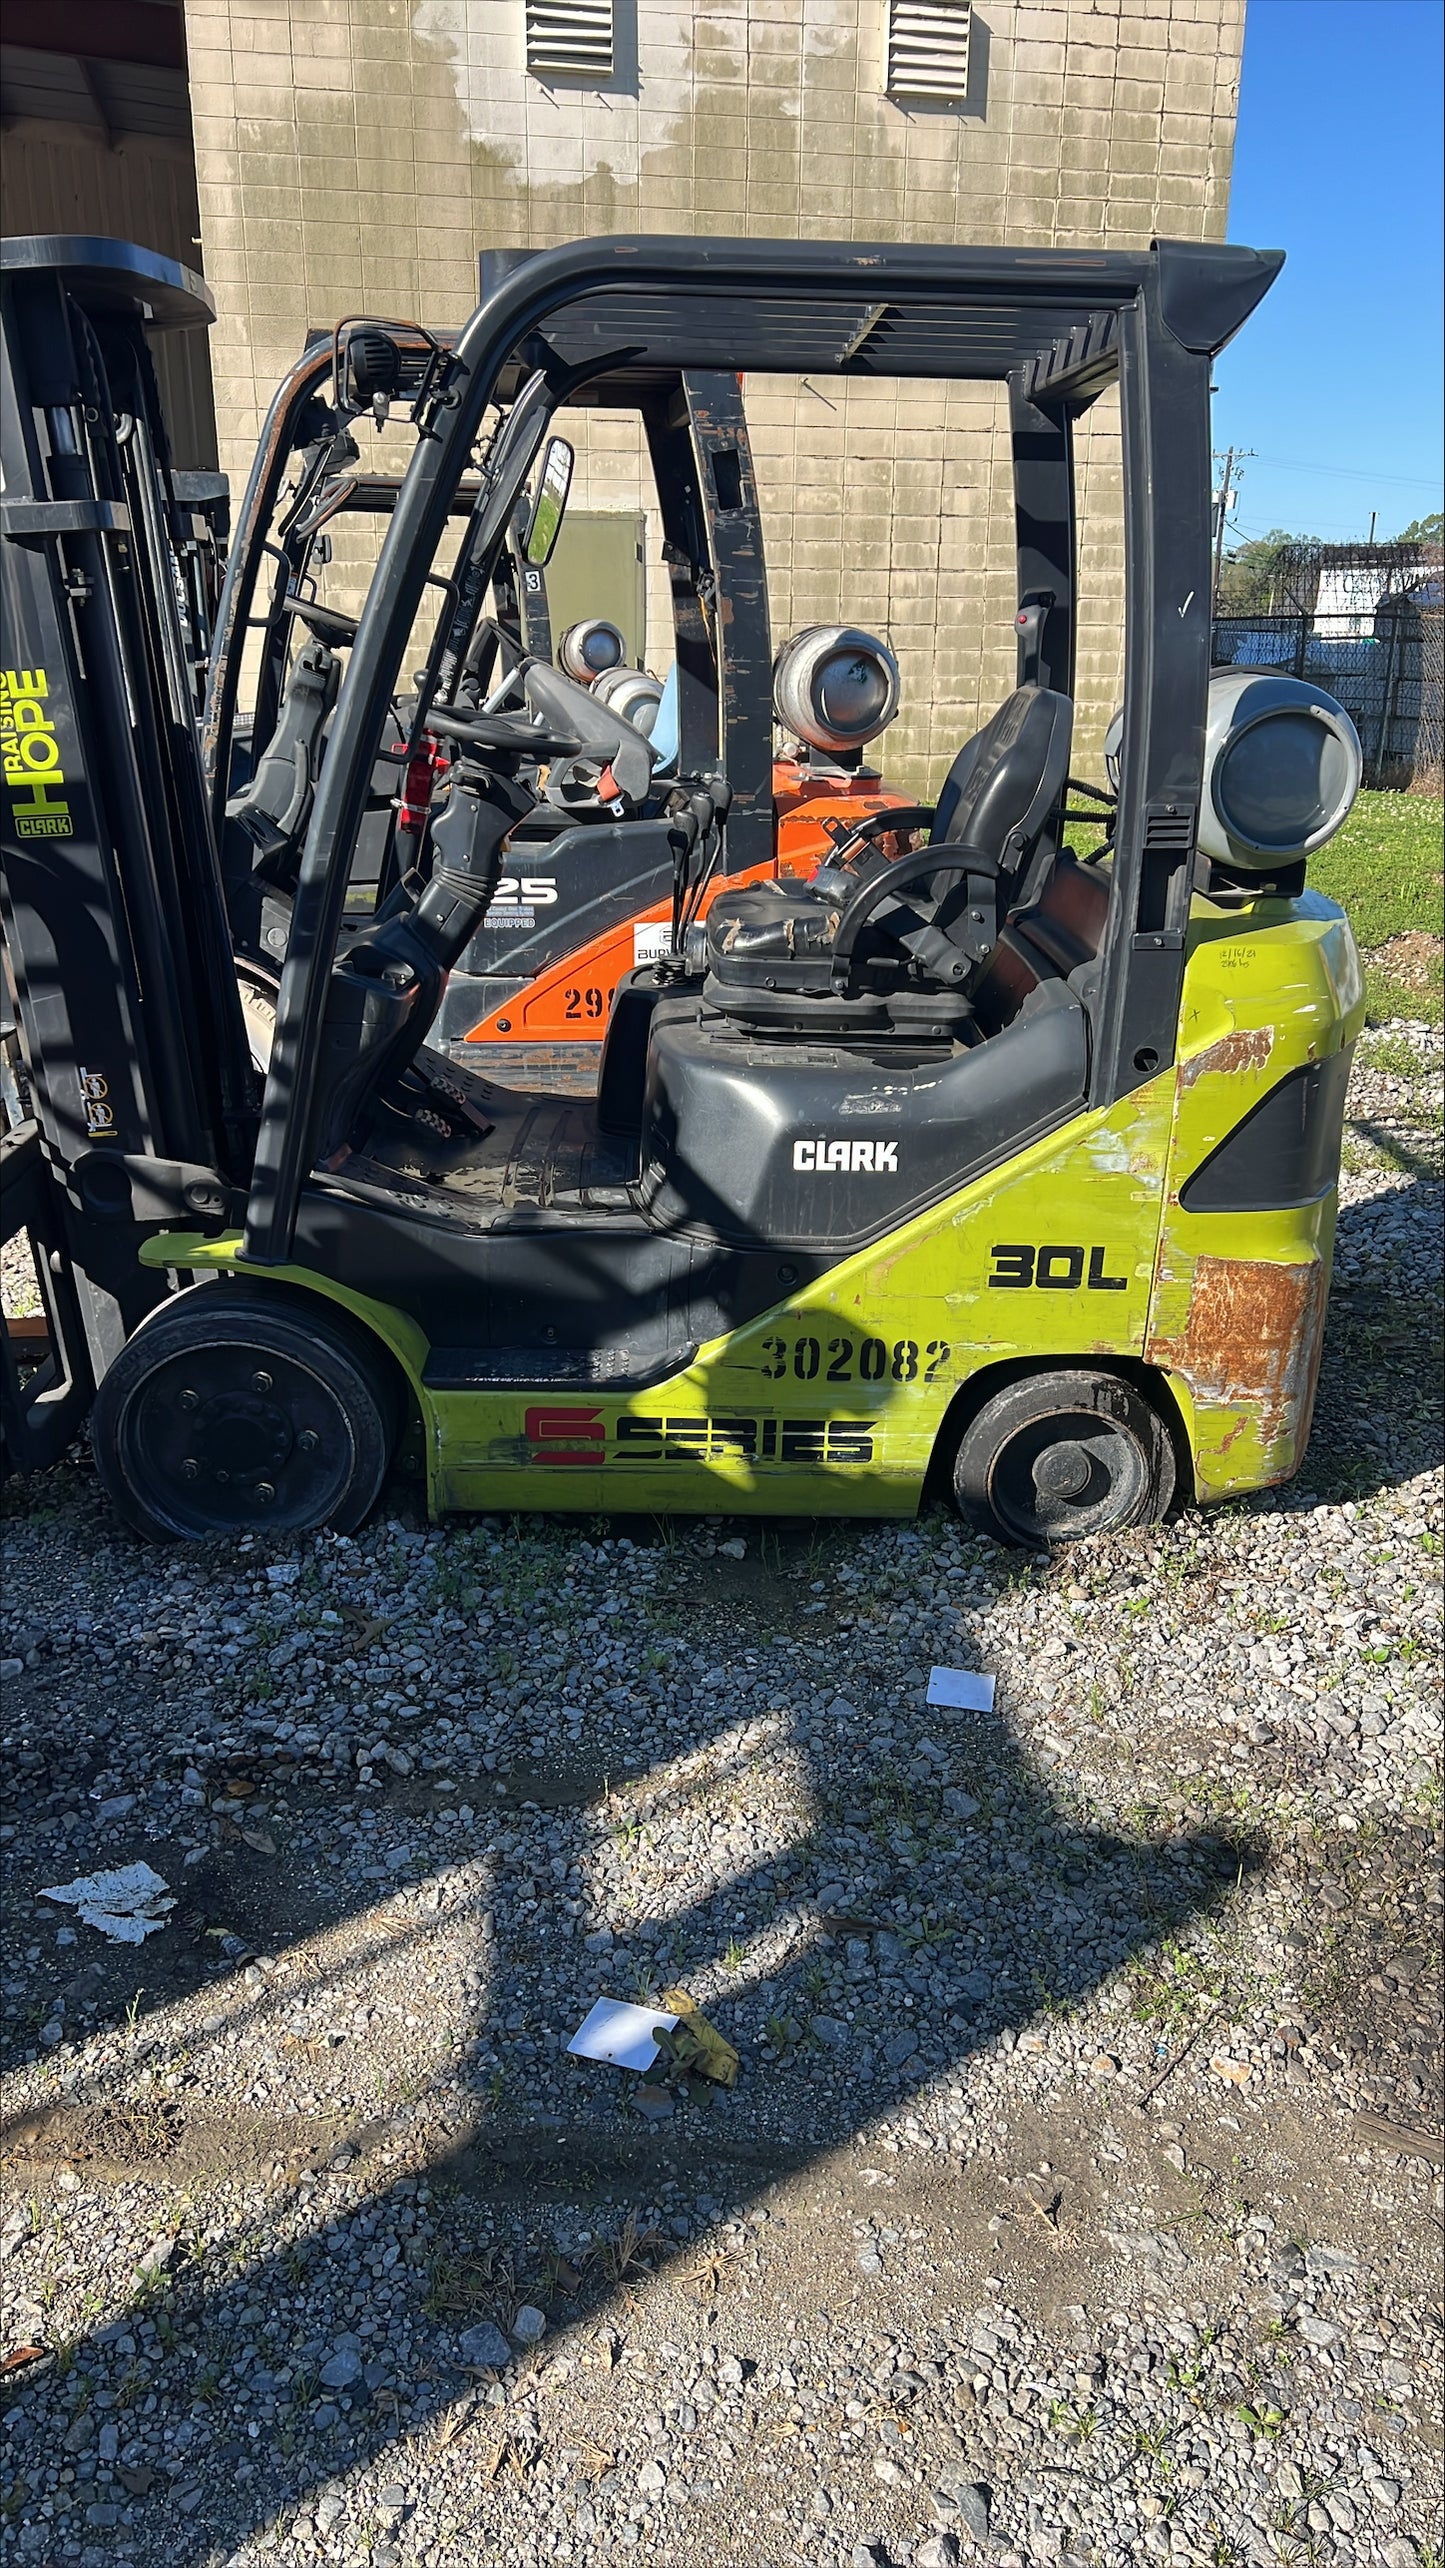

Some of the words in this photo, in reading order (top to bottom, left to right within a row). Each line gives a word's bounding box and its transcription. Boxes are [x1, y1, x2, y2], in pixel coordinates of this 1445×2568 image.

[529, 574, 539, 590] 3
[6, 668, 69, 817] HOPE
[19, 818, 70, 836] CLARK
[490, 877, 558, 904] 25
[484, 917, 536, 929] EQUIPPED
[793, 1140, 899, 1172] CLARK
[988, 1245, 1128, 1290] 30L
[761, 1336, 951, 1382] 302082
[612, 1416, 879, 1463] SERIES
